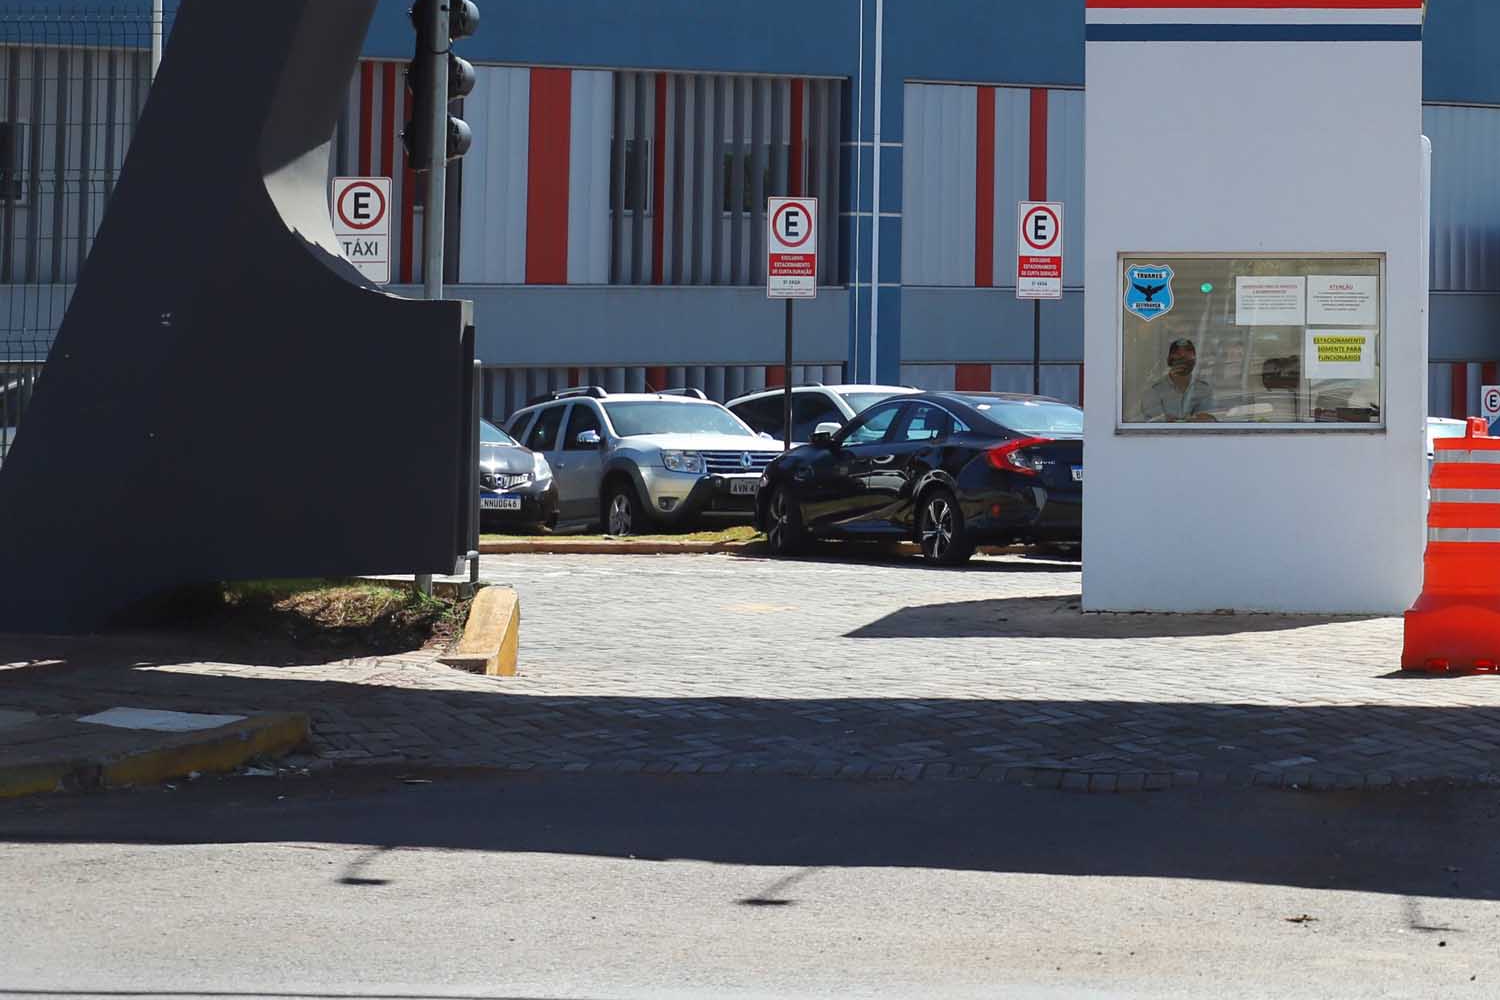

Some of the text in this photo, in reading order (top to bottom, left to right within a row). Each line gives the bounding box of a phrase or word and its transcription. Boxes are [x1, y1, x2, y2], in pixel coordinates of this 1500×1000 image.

[354, 192, 370, 219] E
[785, 211, 799, 237] E
[1035, 216, 1047, 240] E
[343, 238, 378, 256] TÁXI
